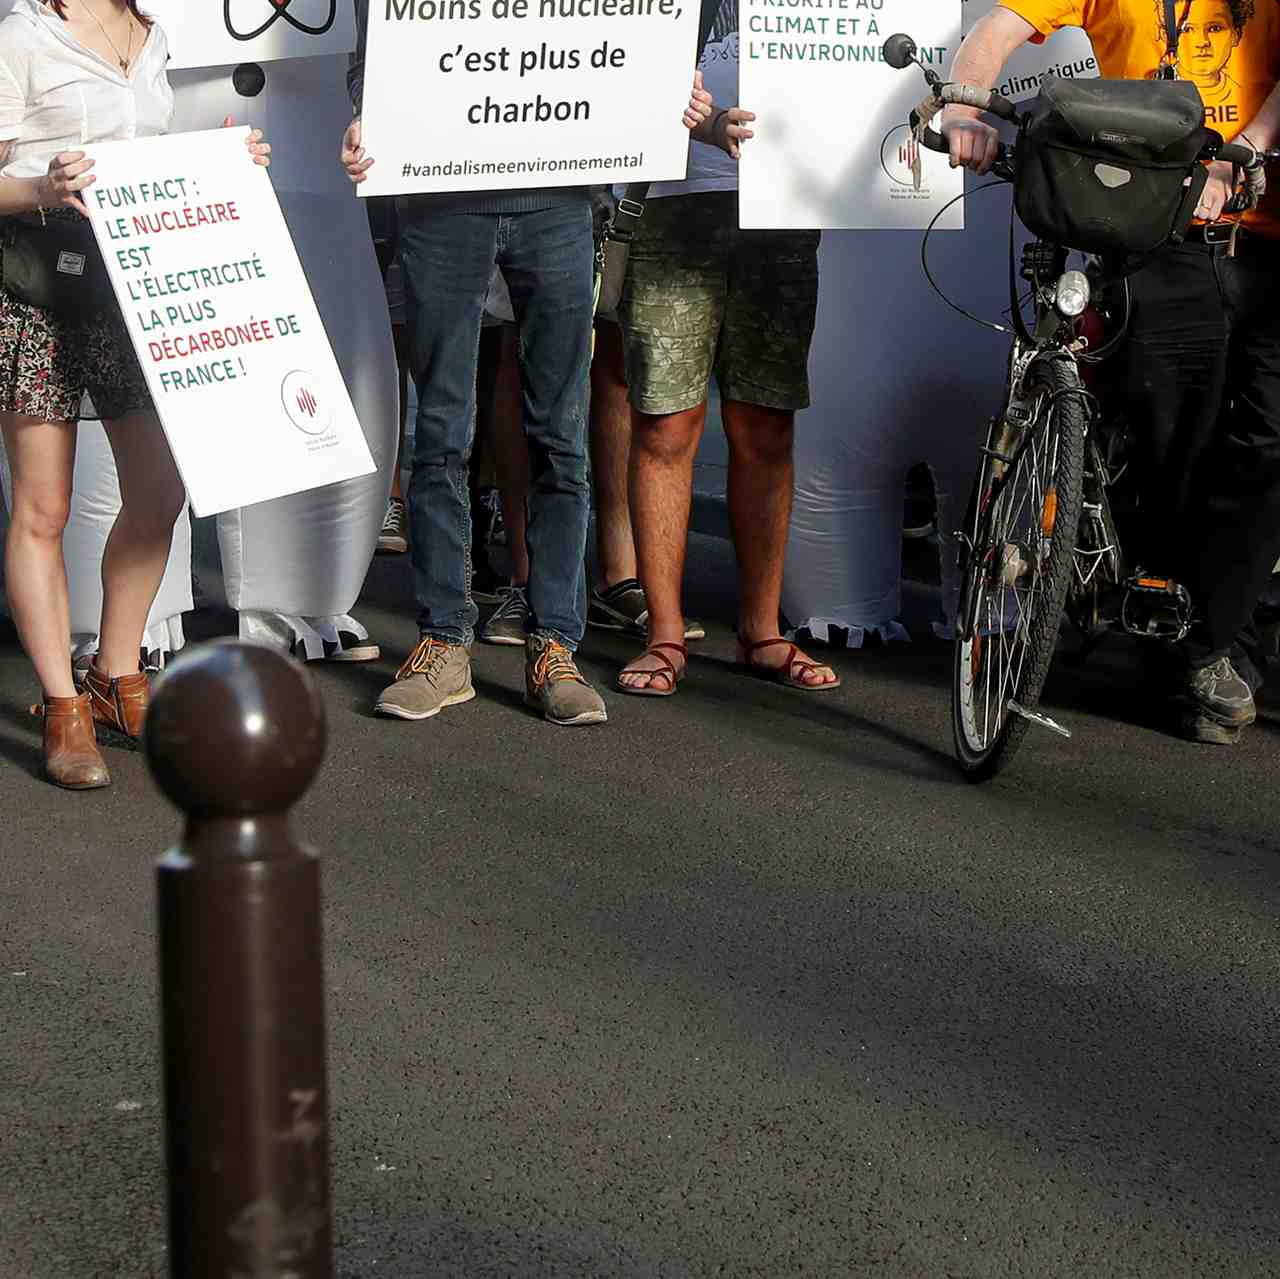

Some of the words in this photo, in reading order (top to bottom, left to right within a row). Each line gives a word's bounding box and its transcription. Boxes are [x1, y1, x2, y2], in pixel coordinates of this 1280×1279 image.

[748, 15, 830, 36] CLIMAT
[836, 18, 860, 36] ET
[866, 13, 880, 36] À
[438, 43, 511, 73] c’est
[519, 42, 581, 78] plus
[590, 40, 627, 69] de
[748, 41, 948, 66] L'ENVIRONNENT
[467, 94, 591, 125] charbon
[1204, 105, 1239, 123] RIE
[400, 152, 643, 178] #vandalismeenvironnemental
[95, 184, 137, 209] FUN
[140, 177, 188, 204] FACT
[193, 179, 201, 196] :
[104, 217, 132, 241] LE
[132, 201, 241, 236] NUCLÉAIRE
[116, 245, 152, 271] EST
[126, 253, 267, 301] L'ÉLECTRICITÉ
[136, 309, 168, 332] LA
[167, 298, 217, 328] PLUS
[148, 316, 275, 362] DÉCARBONÉE
[275, 314, 302, 337] DE
[159, 359, 238, 393] FRANCE
[238, 357, 248, 377] !
